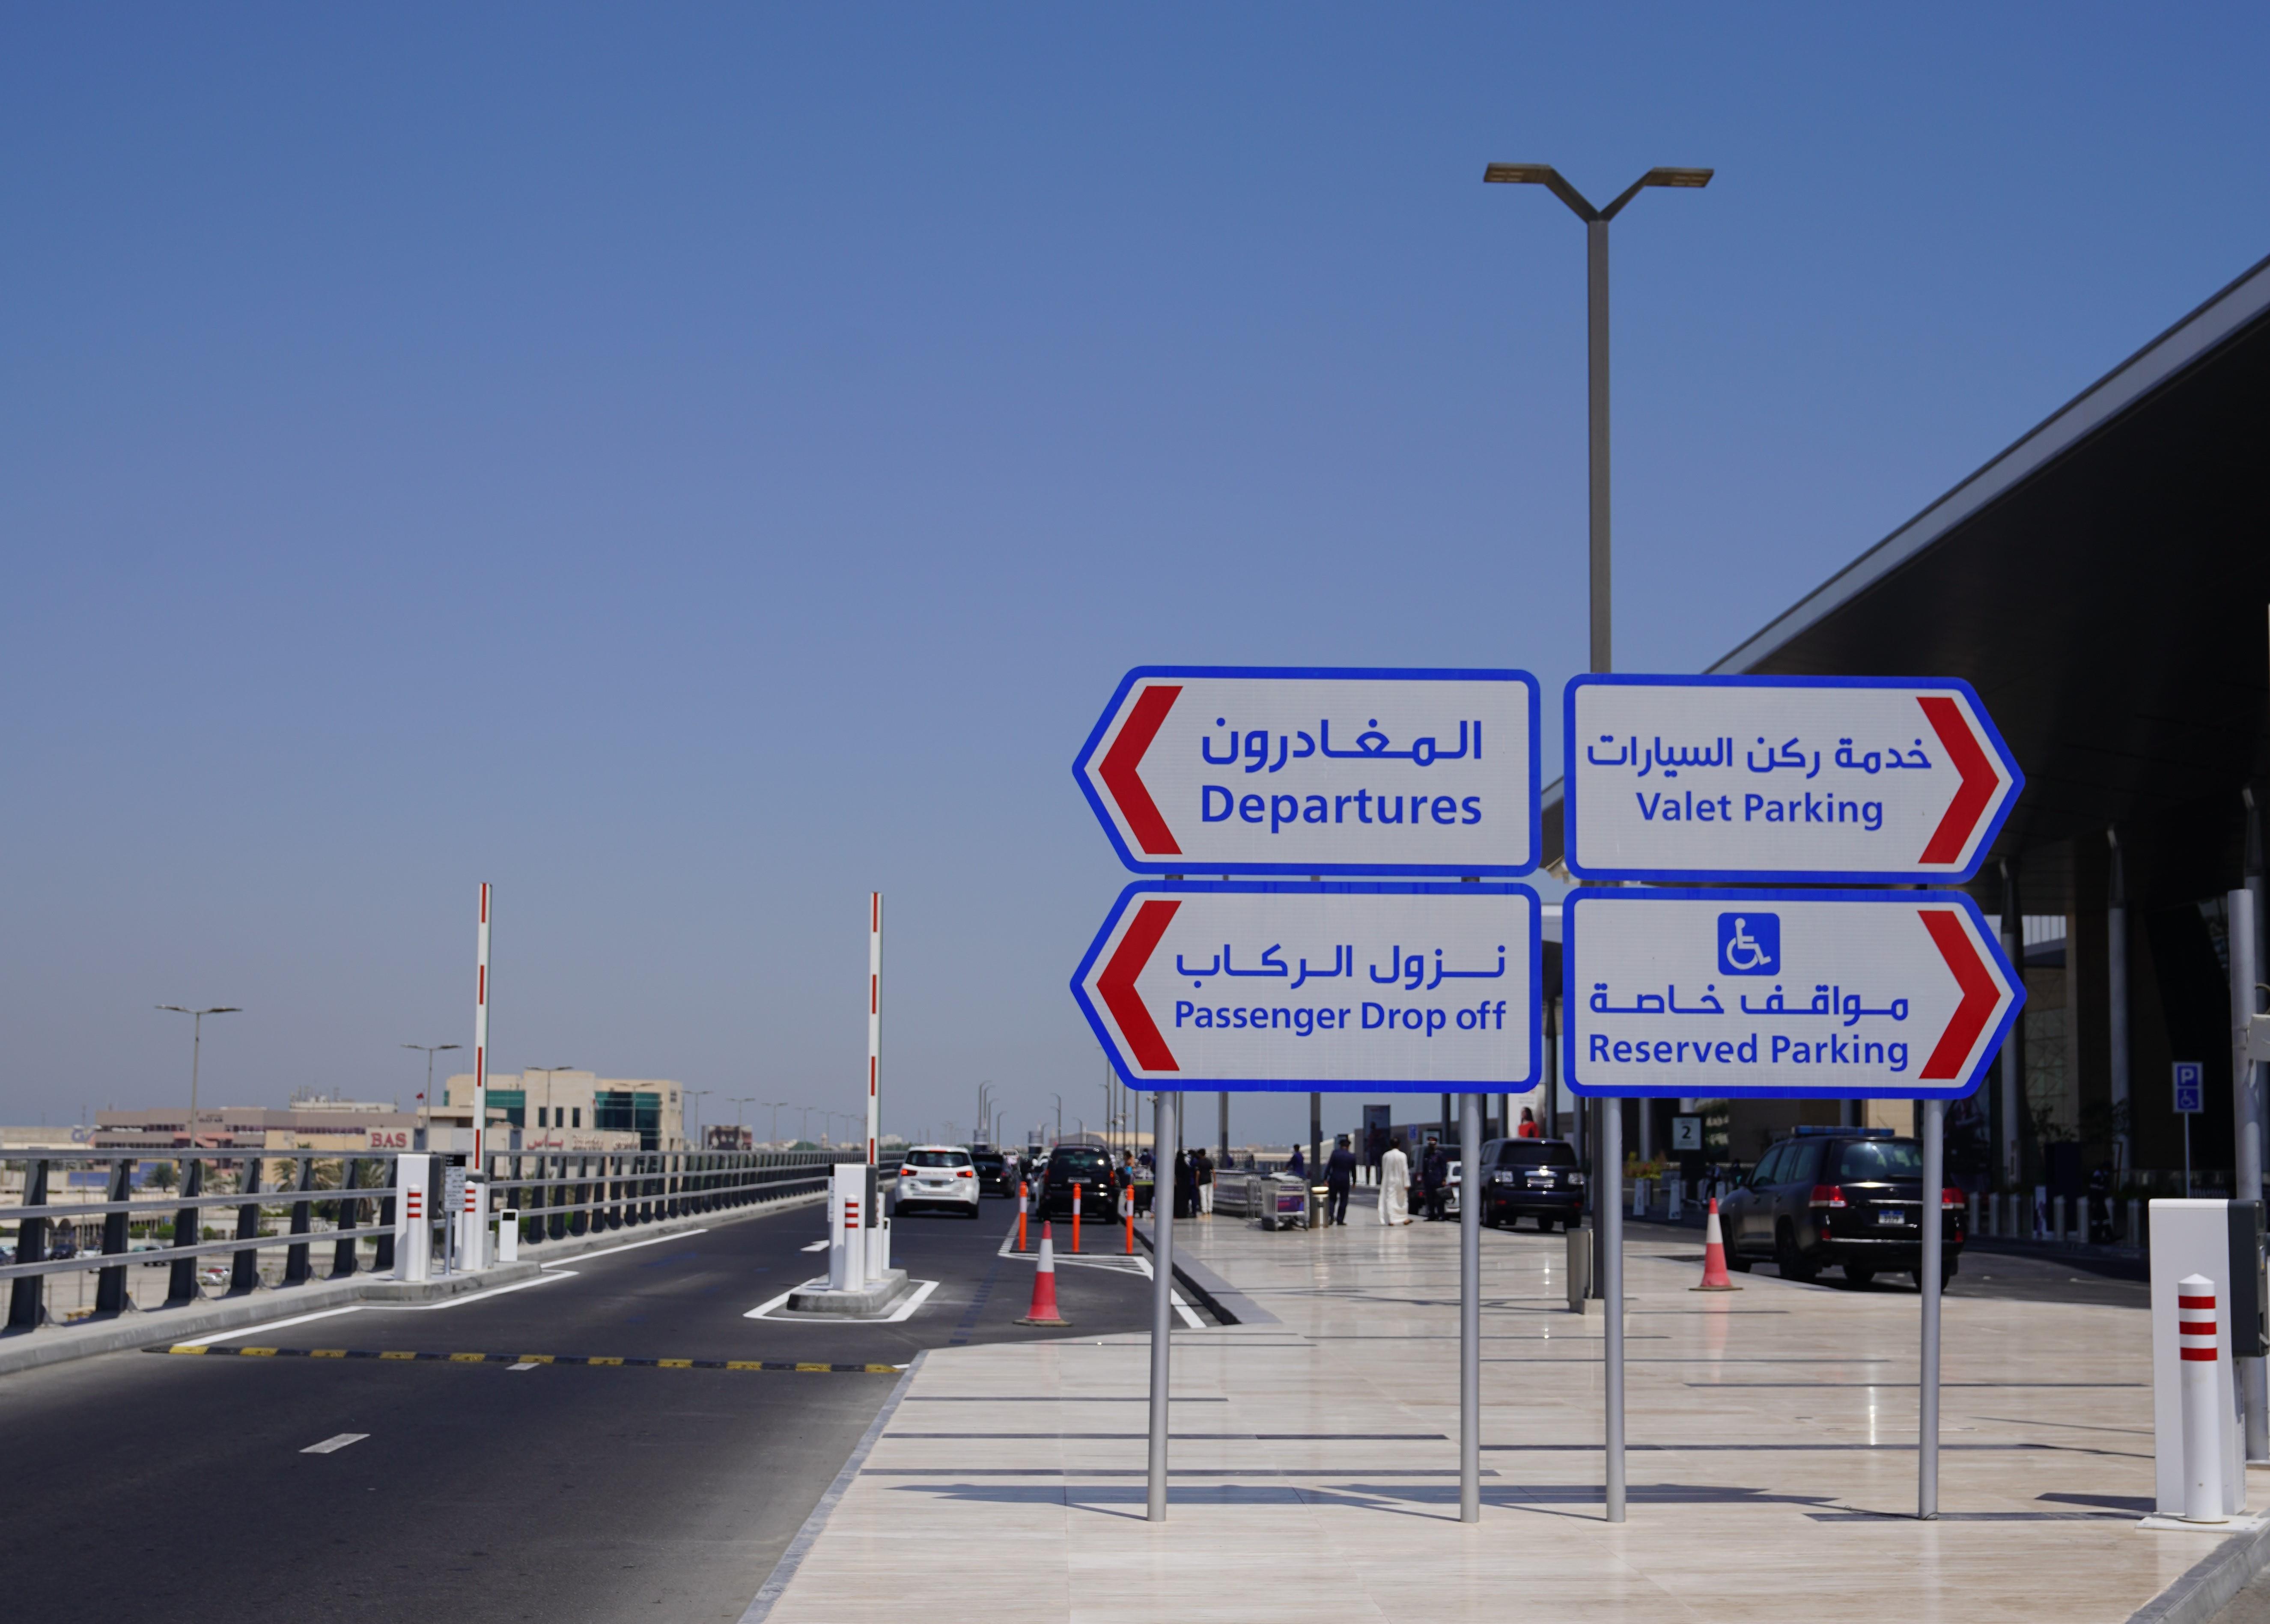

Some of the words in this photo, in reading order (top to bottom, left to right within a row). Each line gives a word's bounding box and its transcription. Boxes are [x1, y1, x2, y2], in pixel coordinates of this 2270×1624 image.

[1202, 717, 1482, 773] المغادرون
[1587, 735, 1733, 778] السيارات
[1747, 736, 1820, 780] ركن
[1834, 737, 1932, 774] خدمة
[1201, 784, 1482, 834] Departures
[1635, 790, 1732, 822] Valet
[1744, 791, 1883, 831] Parking
[1176, 943, 1353, 990] الركاب
[1369, 945, 1506, 991] نزول
[1175, 1000, 1352, 1037] Passenger
[1361, 1001, 1447, 1037] Drop
[1455, 1000, 1507, 1030] off
[1589, 982, 1725, 1015] خاصة
[1740, 983, 1909, 1027] مواقف
[1589, 1032, 1758, 1064] Reserved
[1771, 1033, 1908, 1073] Parking
[2181, 1068, 2194, 1085] P
[370, 1132, 407, 1147] BAS
[1682, 1126, 1691, 1139] 2
